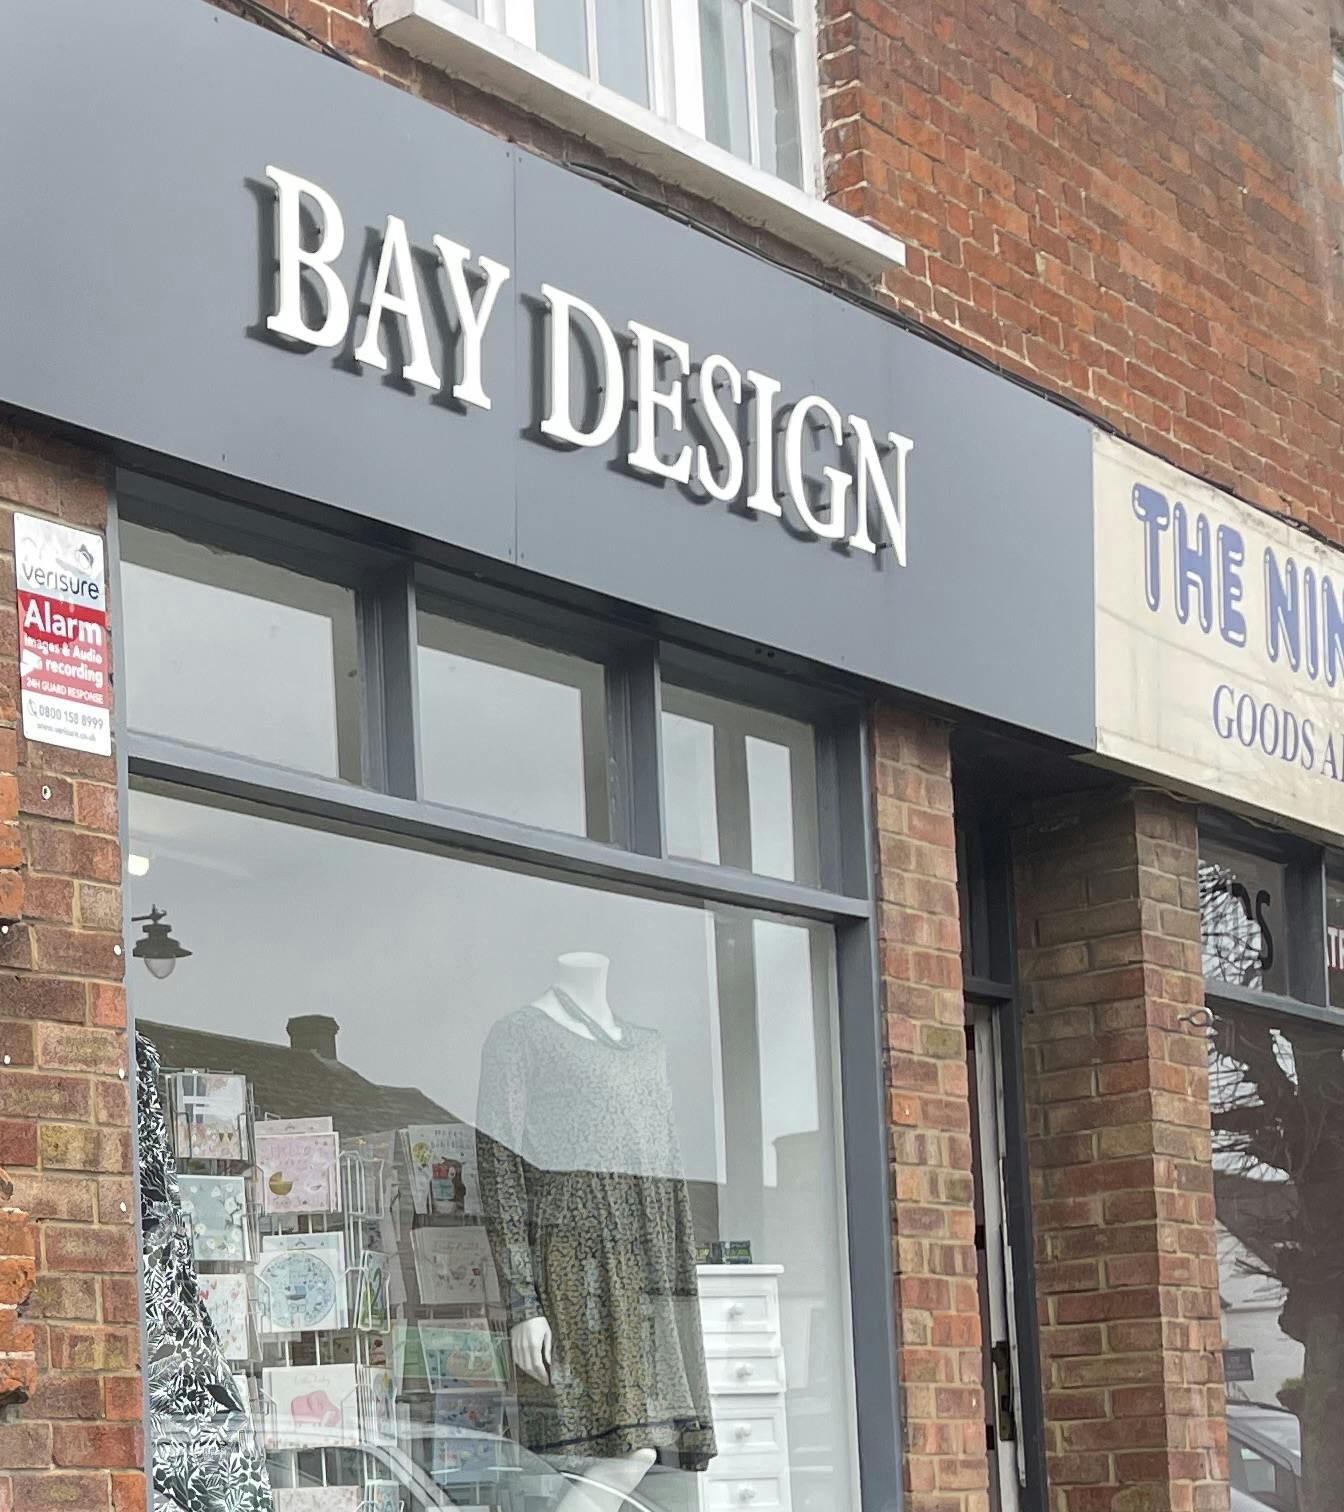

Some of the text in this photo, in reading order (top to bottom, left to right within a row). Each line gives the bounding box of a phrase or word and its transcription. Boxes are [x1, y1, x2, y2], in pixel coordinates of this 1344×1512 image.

[266, 165, 914, 568] BAY DESIGN
[22, 562, 100, 600] verisure
[1131, 481, 1248, 648] THE
[24, 599, 103, 646] Alarm
[24, 634, 103, 664] Images & Audio
[27, 677, 104, 705] 24H GUARD RESPONSE
[45, 659, 104, 688] recording
[1213, 685, 1314, 772] GOODS
